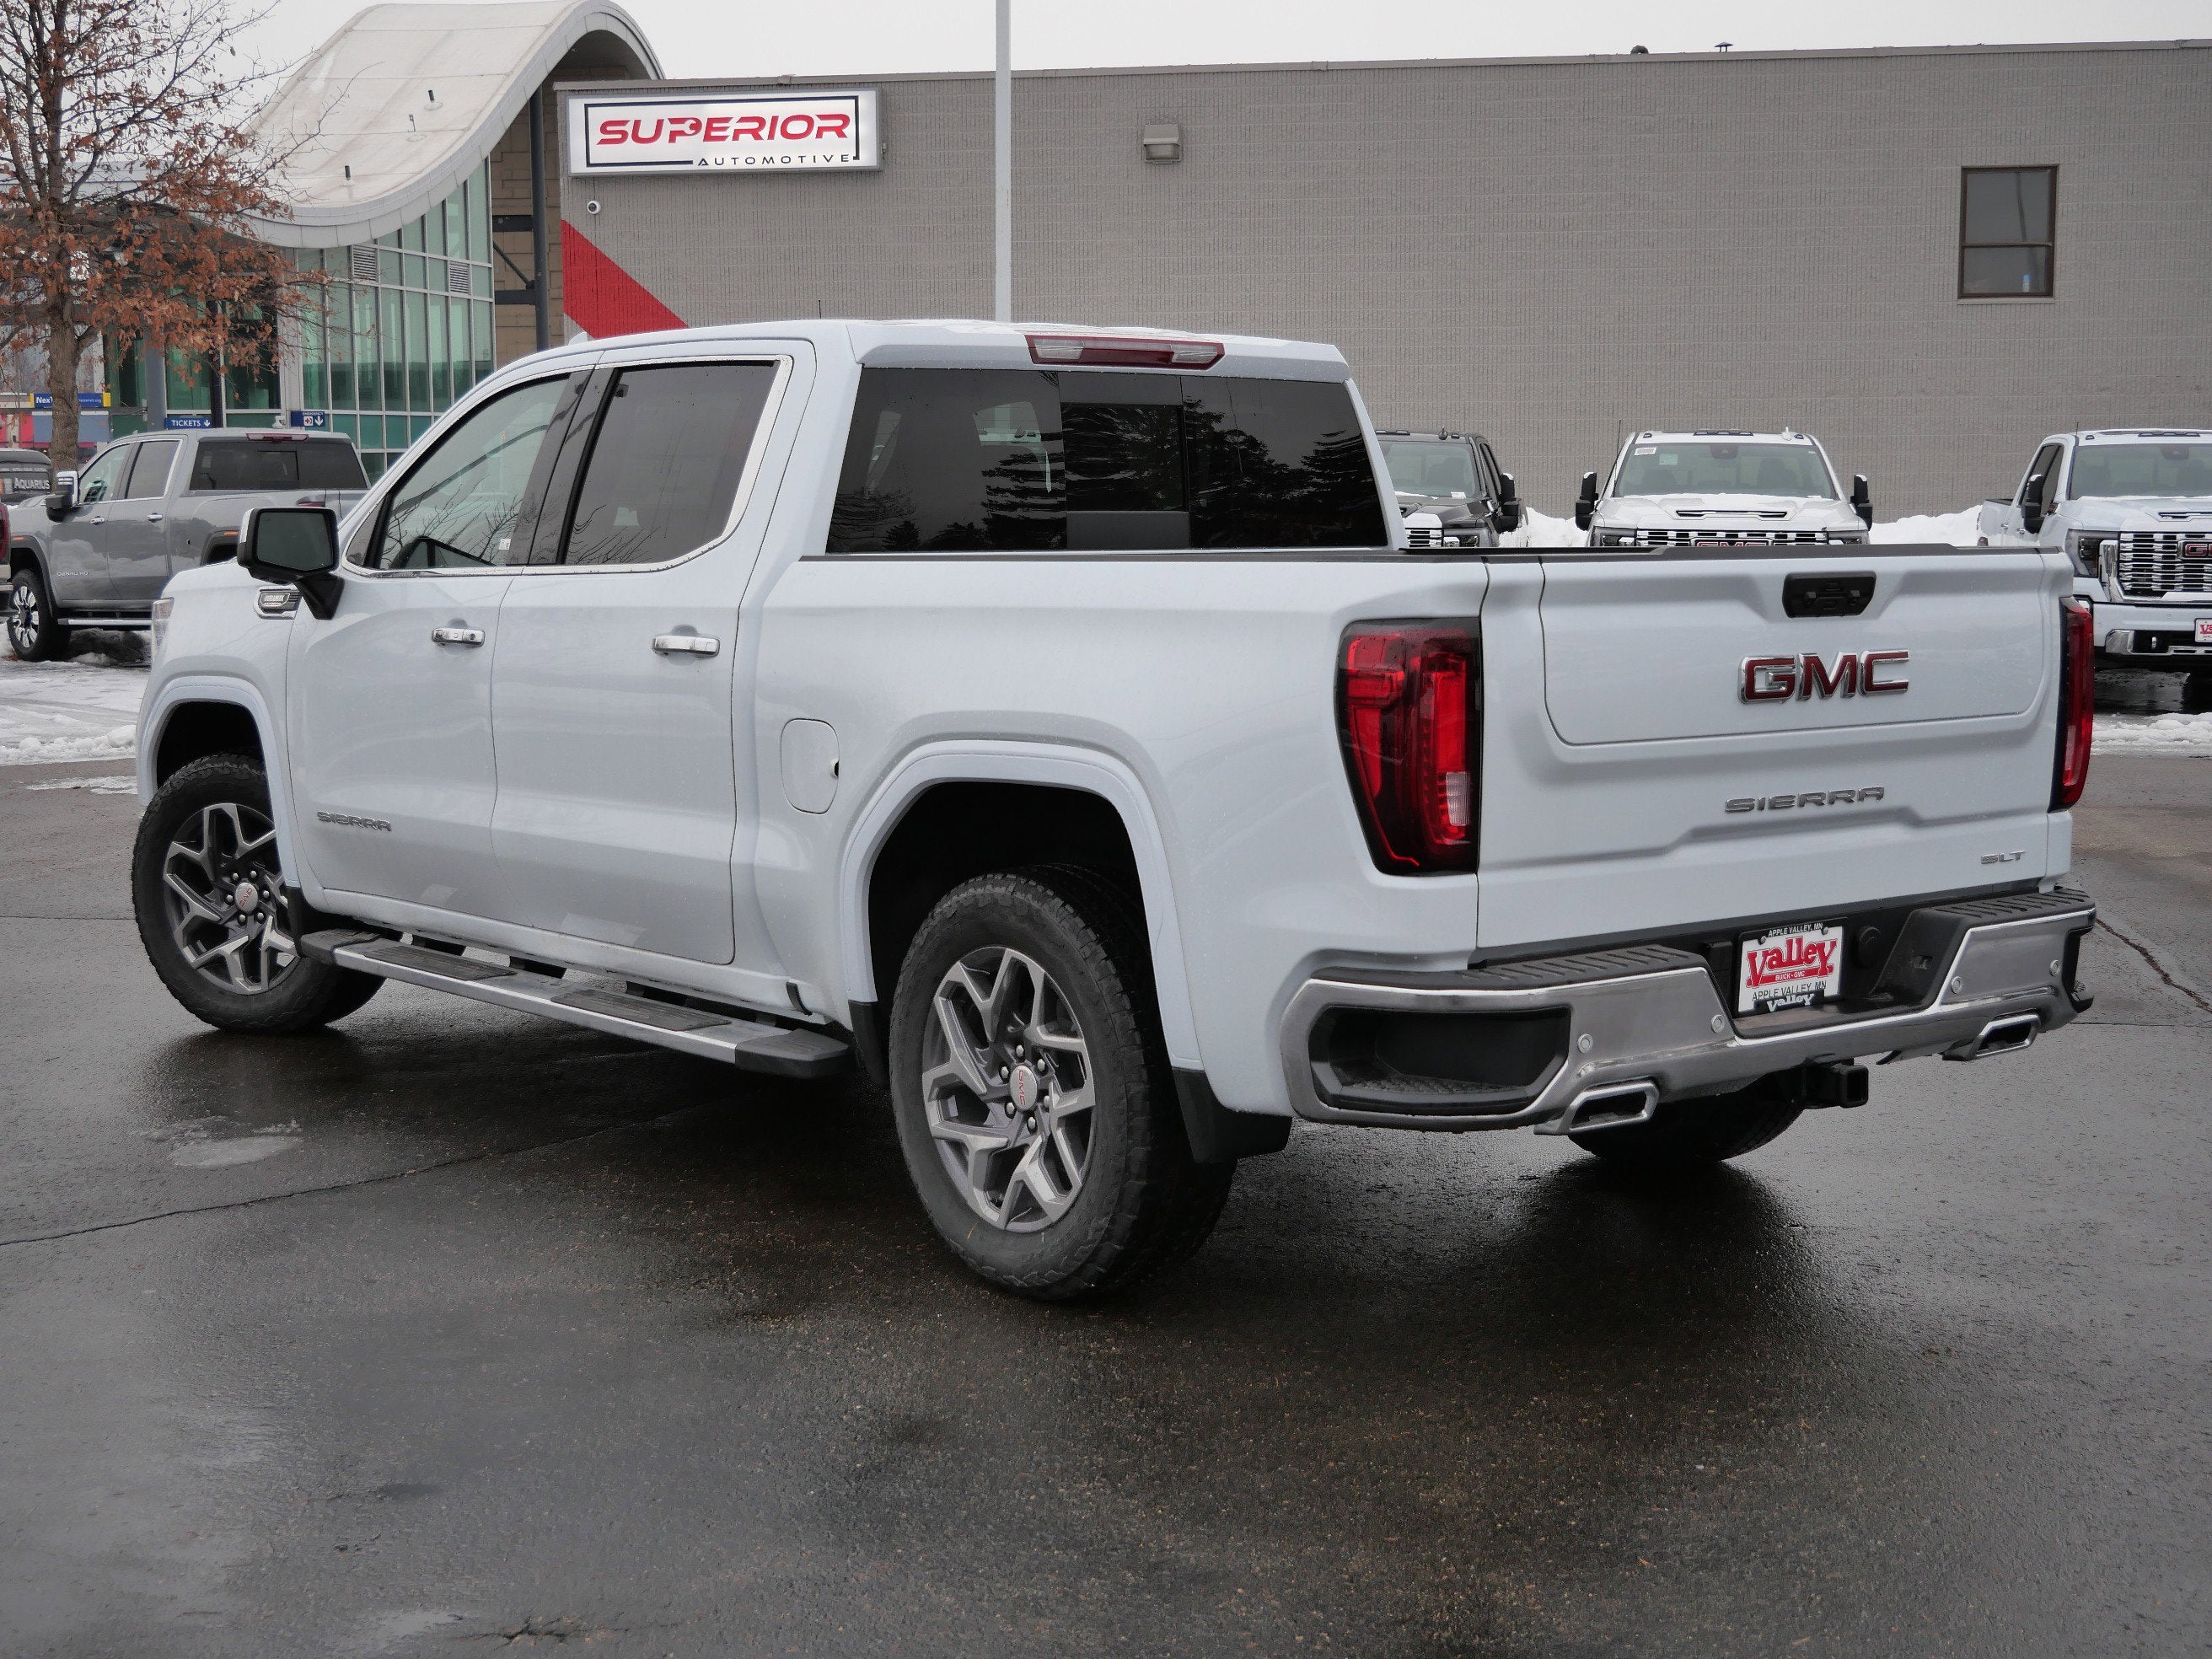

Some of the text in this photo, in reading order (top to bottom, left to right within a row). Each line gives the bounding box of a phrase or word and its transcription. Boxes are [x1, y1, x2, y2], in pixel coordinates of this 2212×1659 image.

[597, 114, 851, 145] SUPERIOR
[698, 154, 850, 166] AUTOMOTIVE
[1738, 648, 1909, 705] GMC
[1725, 786, 1885, 814] SIERRA
[316, 810, 392, 832] SIERRA
[1980, 850, 2026, 865] SLT
[1768, 928, 1788, 937] APPLE
[1746, 936, 1838, 989] Valley
[1774, 973, 1791, 981] BUICK
[1753, 988, 1780, 1001] APPLE
[1814, 980, 1828, 991] MN
[1017, 1070, 1026, 1106] GMC
